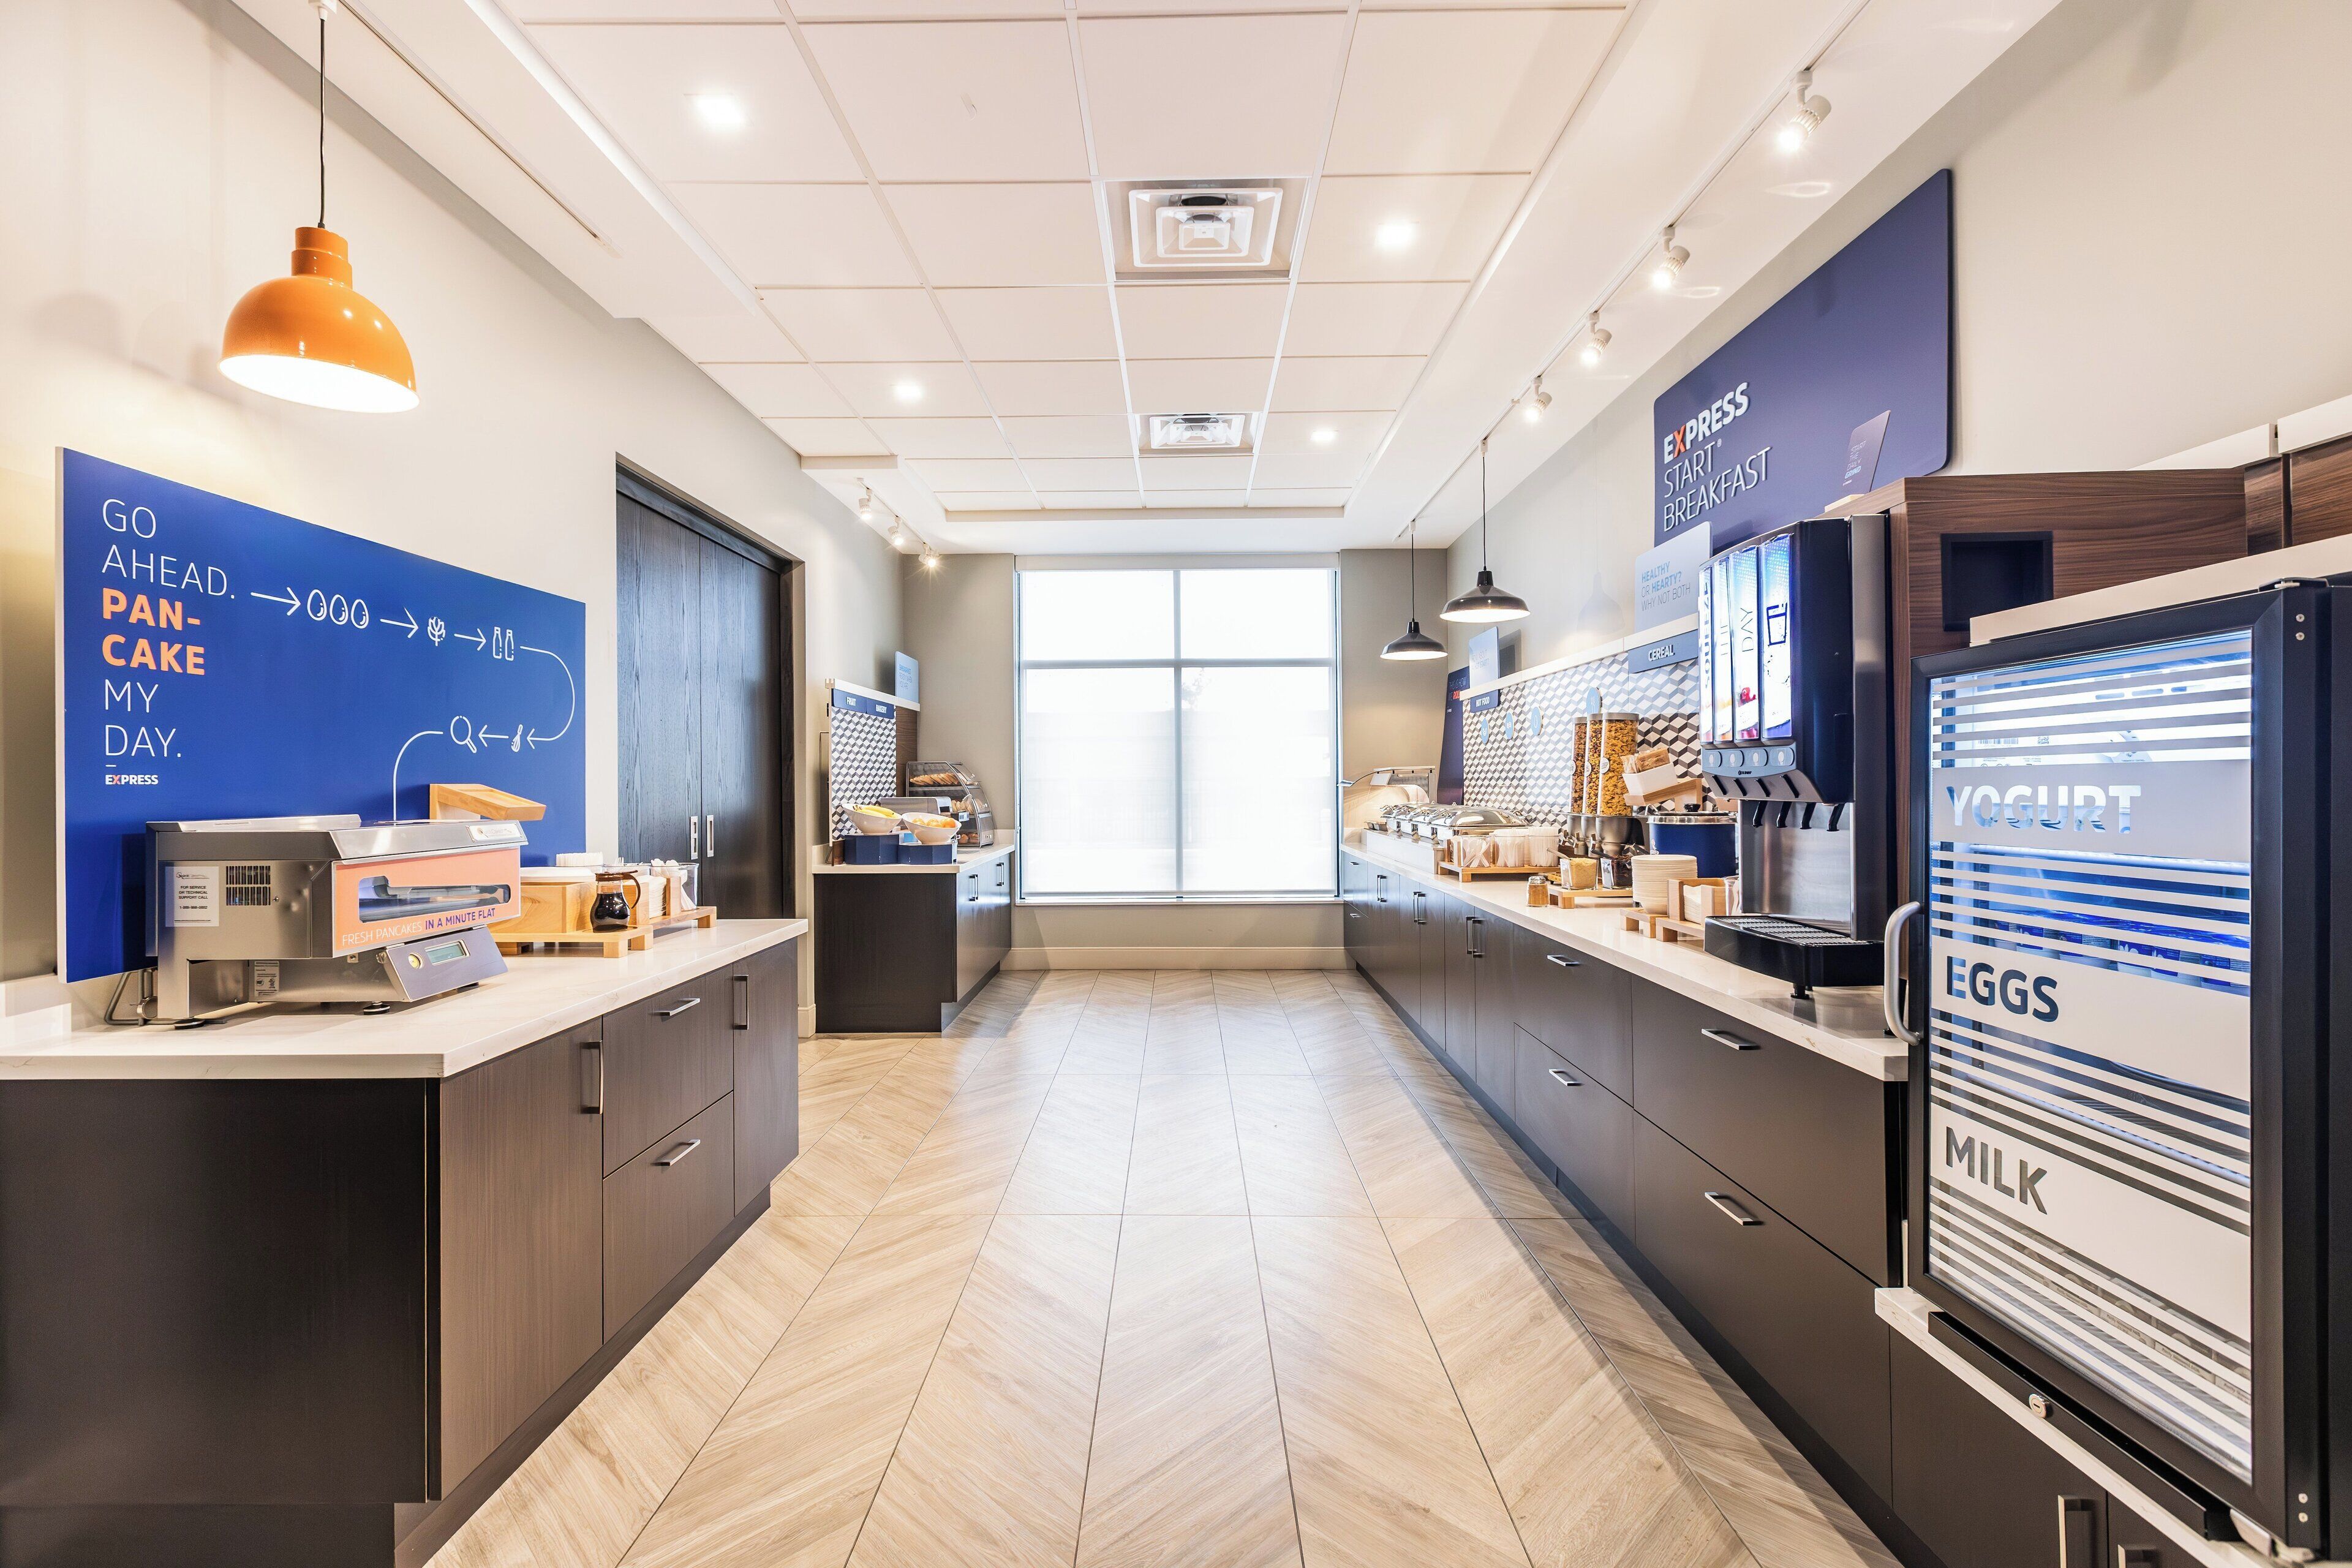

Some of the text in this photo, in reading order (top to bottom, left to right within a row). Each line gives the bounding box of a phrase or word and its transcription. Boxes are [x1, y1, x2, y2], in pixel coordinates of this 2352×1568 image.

[1664, 382, 1749, 464] EXPRESS
[1664, 447, 1772, 532] BREAKFAST
[1844, 466, 1862, 479] GRIND
[102, 499, 157, 538] GO
[102, 545, 235, 599] AHEAD.
[1642, 561, 1670, 582] HEALTHY
[1642, 571, 1682, 598] OR HEARTY?
[102, 587, 201, 631] PAN-
[1642, 582, 1691, 611] WHY NOT BOTH
[1740, 607, 1754, 652] DAY
[102, 634, 205, 676] CAKE
[1648, 644, 1675, 662] CEREAL
[105, 679, 159, 713] MY
[846, 696, 856, 707] FRUIT
[875, 704, 887, 714] BAKERY
[105, 725, 182, 757] DAY.
[105, 774, 159, 785] EXPRESS
[1946, 785, 2141, 834] YOGURT
[342, 908, 496, 946] FRESH PANCAKES IN A MINUTE FLAT
[1947, 956, 2059, 1023] EGGS
[1946, 1126, 2048, 1215] MILK
